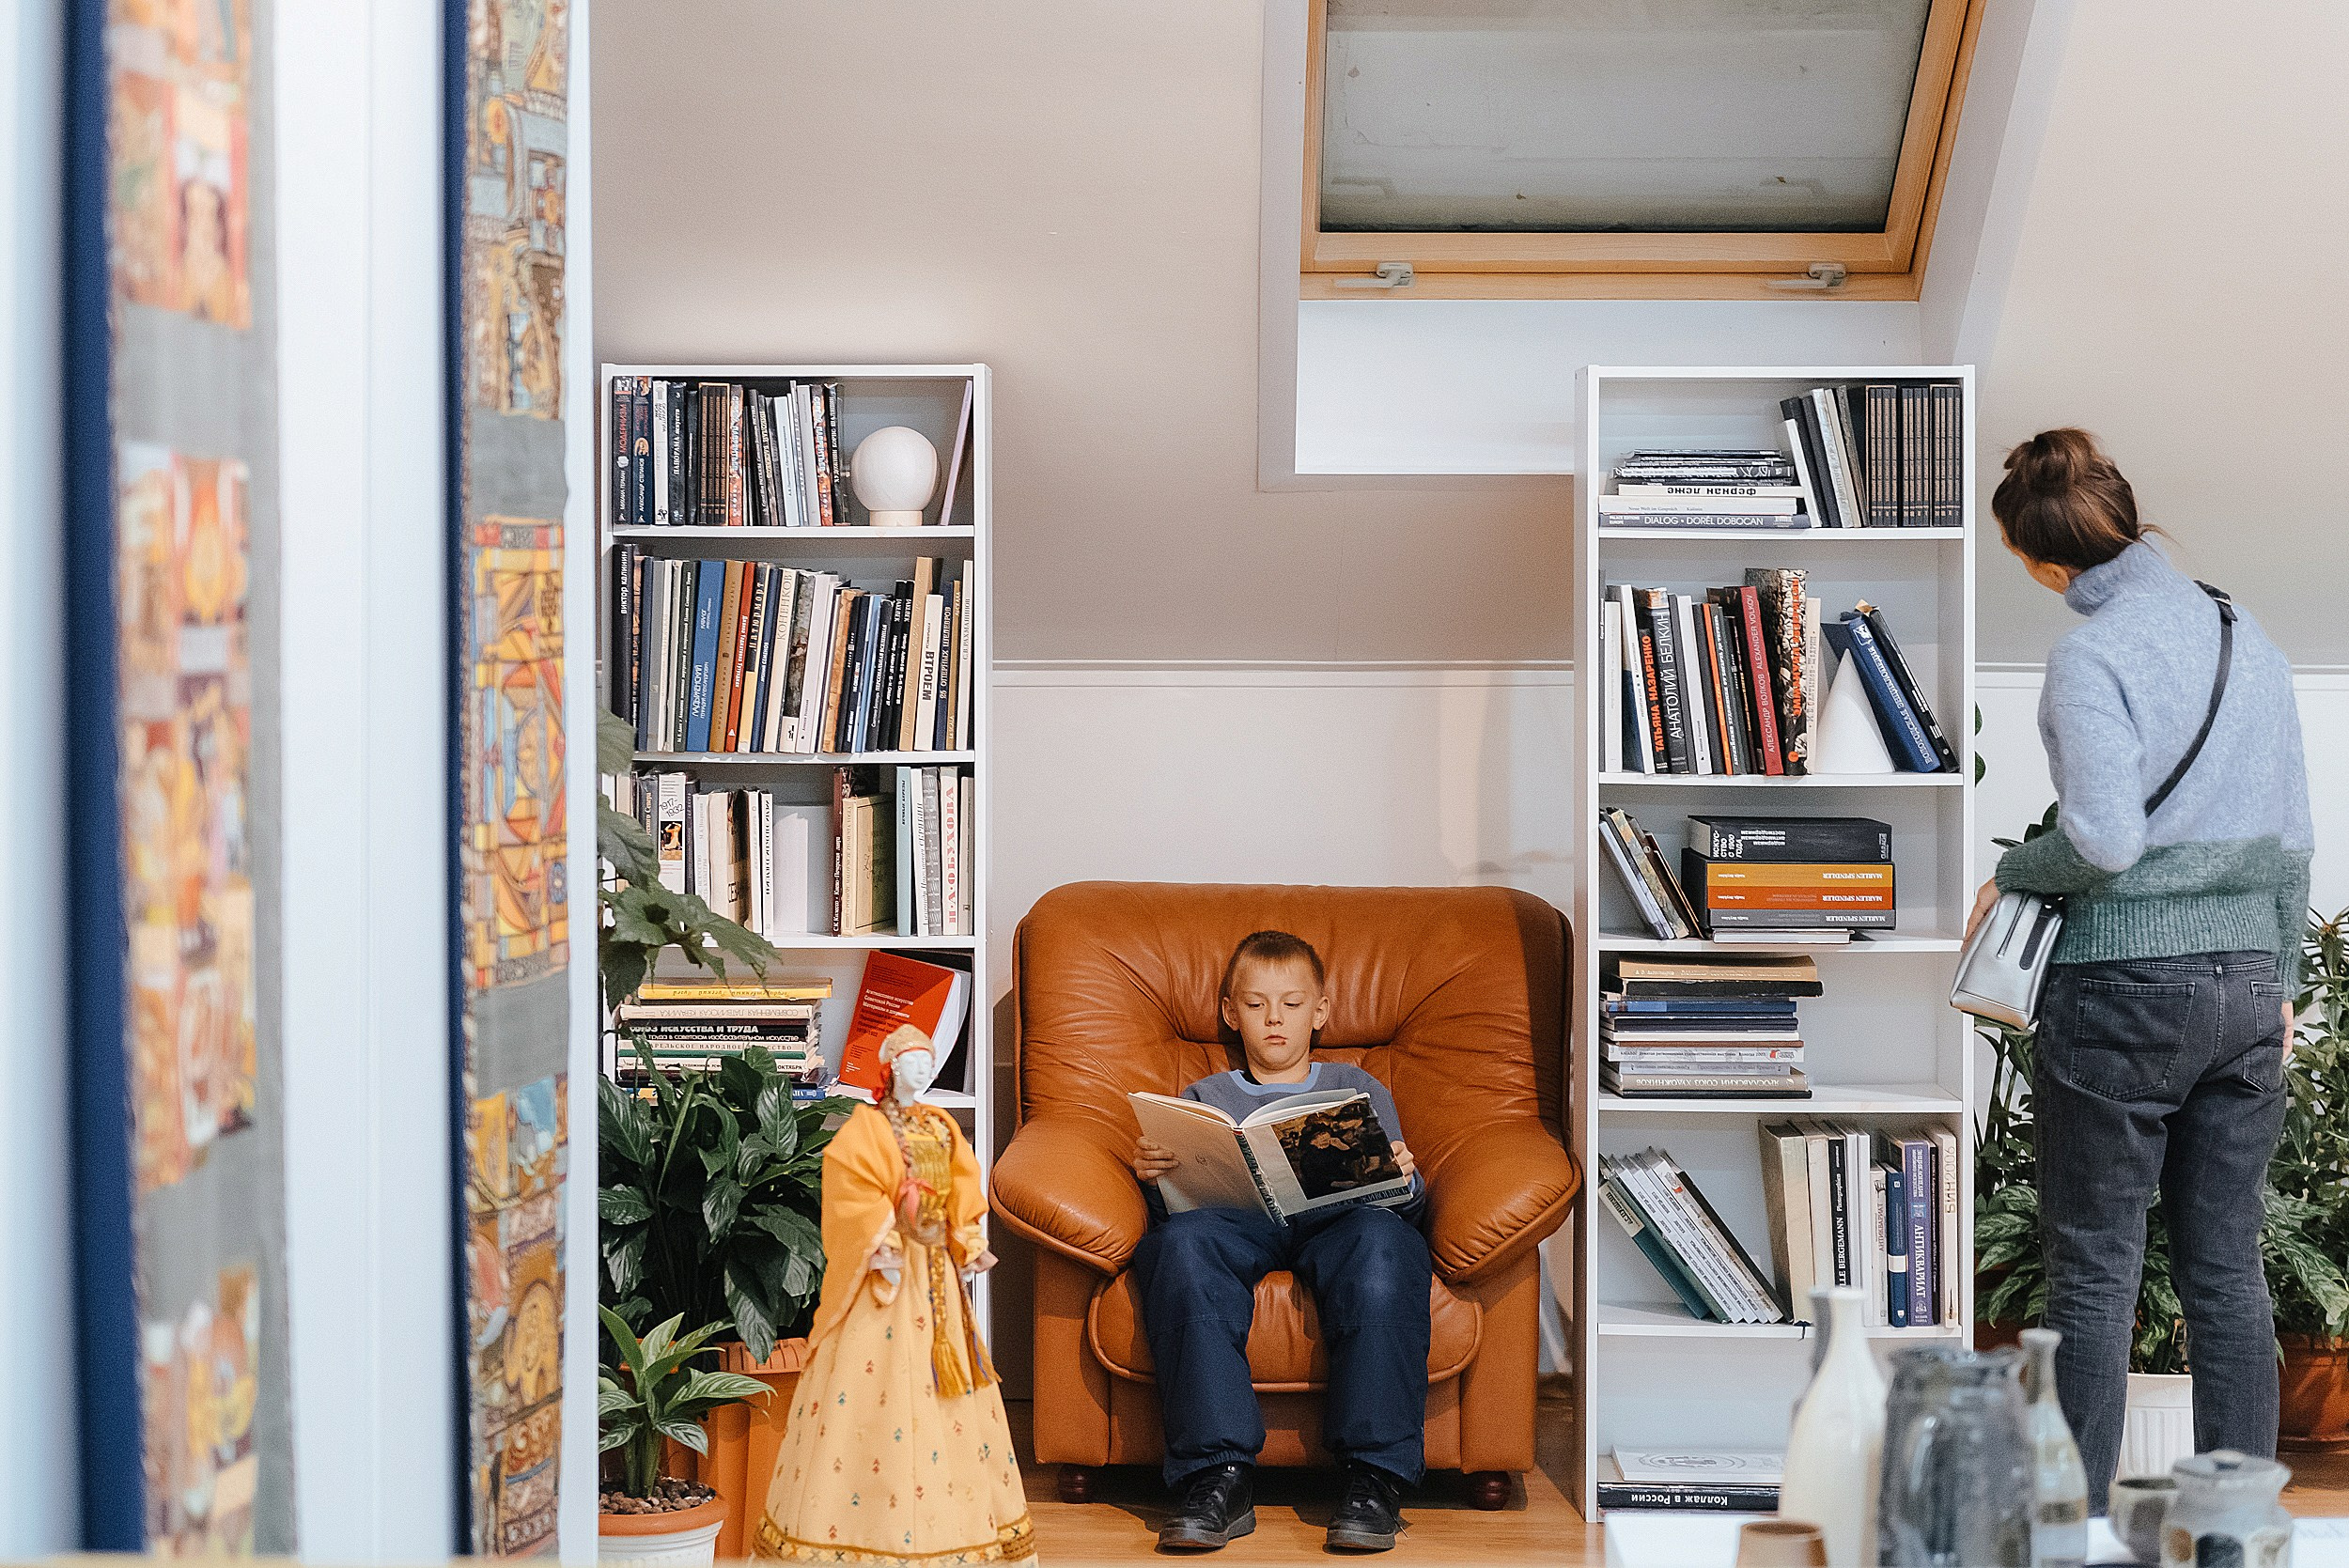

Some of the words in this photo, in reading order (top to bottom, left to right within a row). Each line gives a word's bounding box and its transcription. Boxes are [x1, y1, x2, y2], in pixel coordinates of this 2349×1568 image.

[619, 404, 628, 453] МОДЕРНИЗМ
[1666, 487, 1699, 495] леже
[1705, 487, 1755, 496] фернан
[1642, 517, 1677, 525] DIALOG
[1685, 515, 1714, 525] DORÉL
[1715, 517, 1763, 526] DOBOCAN
[620, 551, 629, 584] калинин
[620, 587, 629, 614] виктор
[749, 582, 764, 648] НАТЮРМОРТ
[1746, 595, 1757, 625] VOLKOV
[1657, 612, 1673, 664] БЕЛКИН
[1750, 626, 1764, 670] ALEXANDER
[922, 651, 935, 701] ВТРОЕМ
[940, 650, 949, 687] ОПЕРНЫХ
[1641, 635, 1658, 702] НАЗАРЕНКО
[1792, 647, 1801, 717] ЭММАНУИЛ
[1867, 646, 1904, 712] ЭНЦИКЛОПЕДИЯ
[692, 664, 703, 717] ЛАДЫЖЕНСКИЙ
[1659, 669, 1683, 739] АНАТОЛИЙ
[1758, 674, 1769, 706] ВОЛКОВ
[1651, 705, 1665, 753] ТАТЬЯНА
[1762, 708, 1775, 753] АЛЕКСАНДР
[1900, 708, 1932, 765] ВОЛОГОДСКАЯ
[666, 804, 684, 818] 1932
[1735, 839, 1744, 859] ГОДА
[660, 1008, 697, 1017] КЕРАМИКА
[699, 1008, 744, 1017] ЛАТВИЙСКАЯ
[747, 1008, 799, 1017] СОВРЕМЕННАЯ
[661, 1025, 714, 1033] ИСКУССТВА
[717, 1025, 724, 1033] И
[726, 1025, 758, 1033] ТРУДА
[650, 1042, 696, 1050] АРЕЛЬСКОЕ
[1635, 1079, 1691, 1087] ХУДОЖНИКОВ
[1694, 1079, 1718, 1087] СОЮЗ
[1720, 1079, 1780, 1087] ЯРОСЛАВСКИЙ
[1361, 1187, 1408, 1203] ЖИВОПИСЬ
[1836, 1217, 1847, 1269] BERGEMANN
[1914, 1223, 1926, 1297] АНТИКВАРИАТ
[1631, 1494, 1670, 1505] России
[1685, 1496, 1728, 1506] Коллаж
